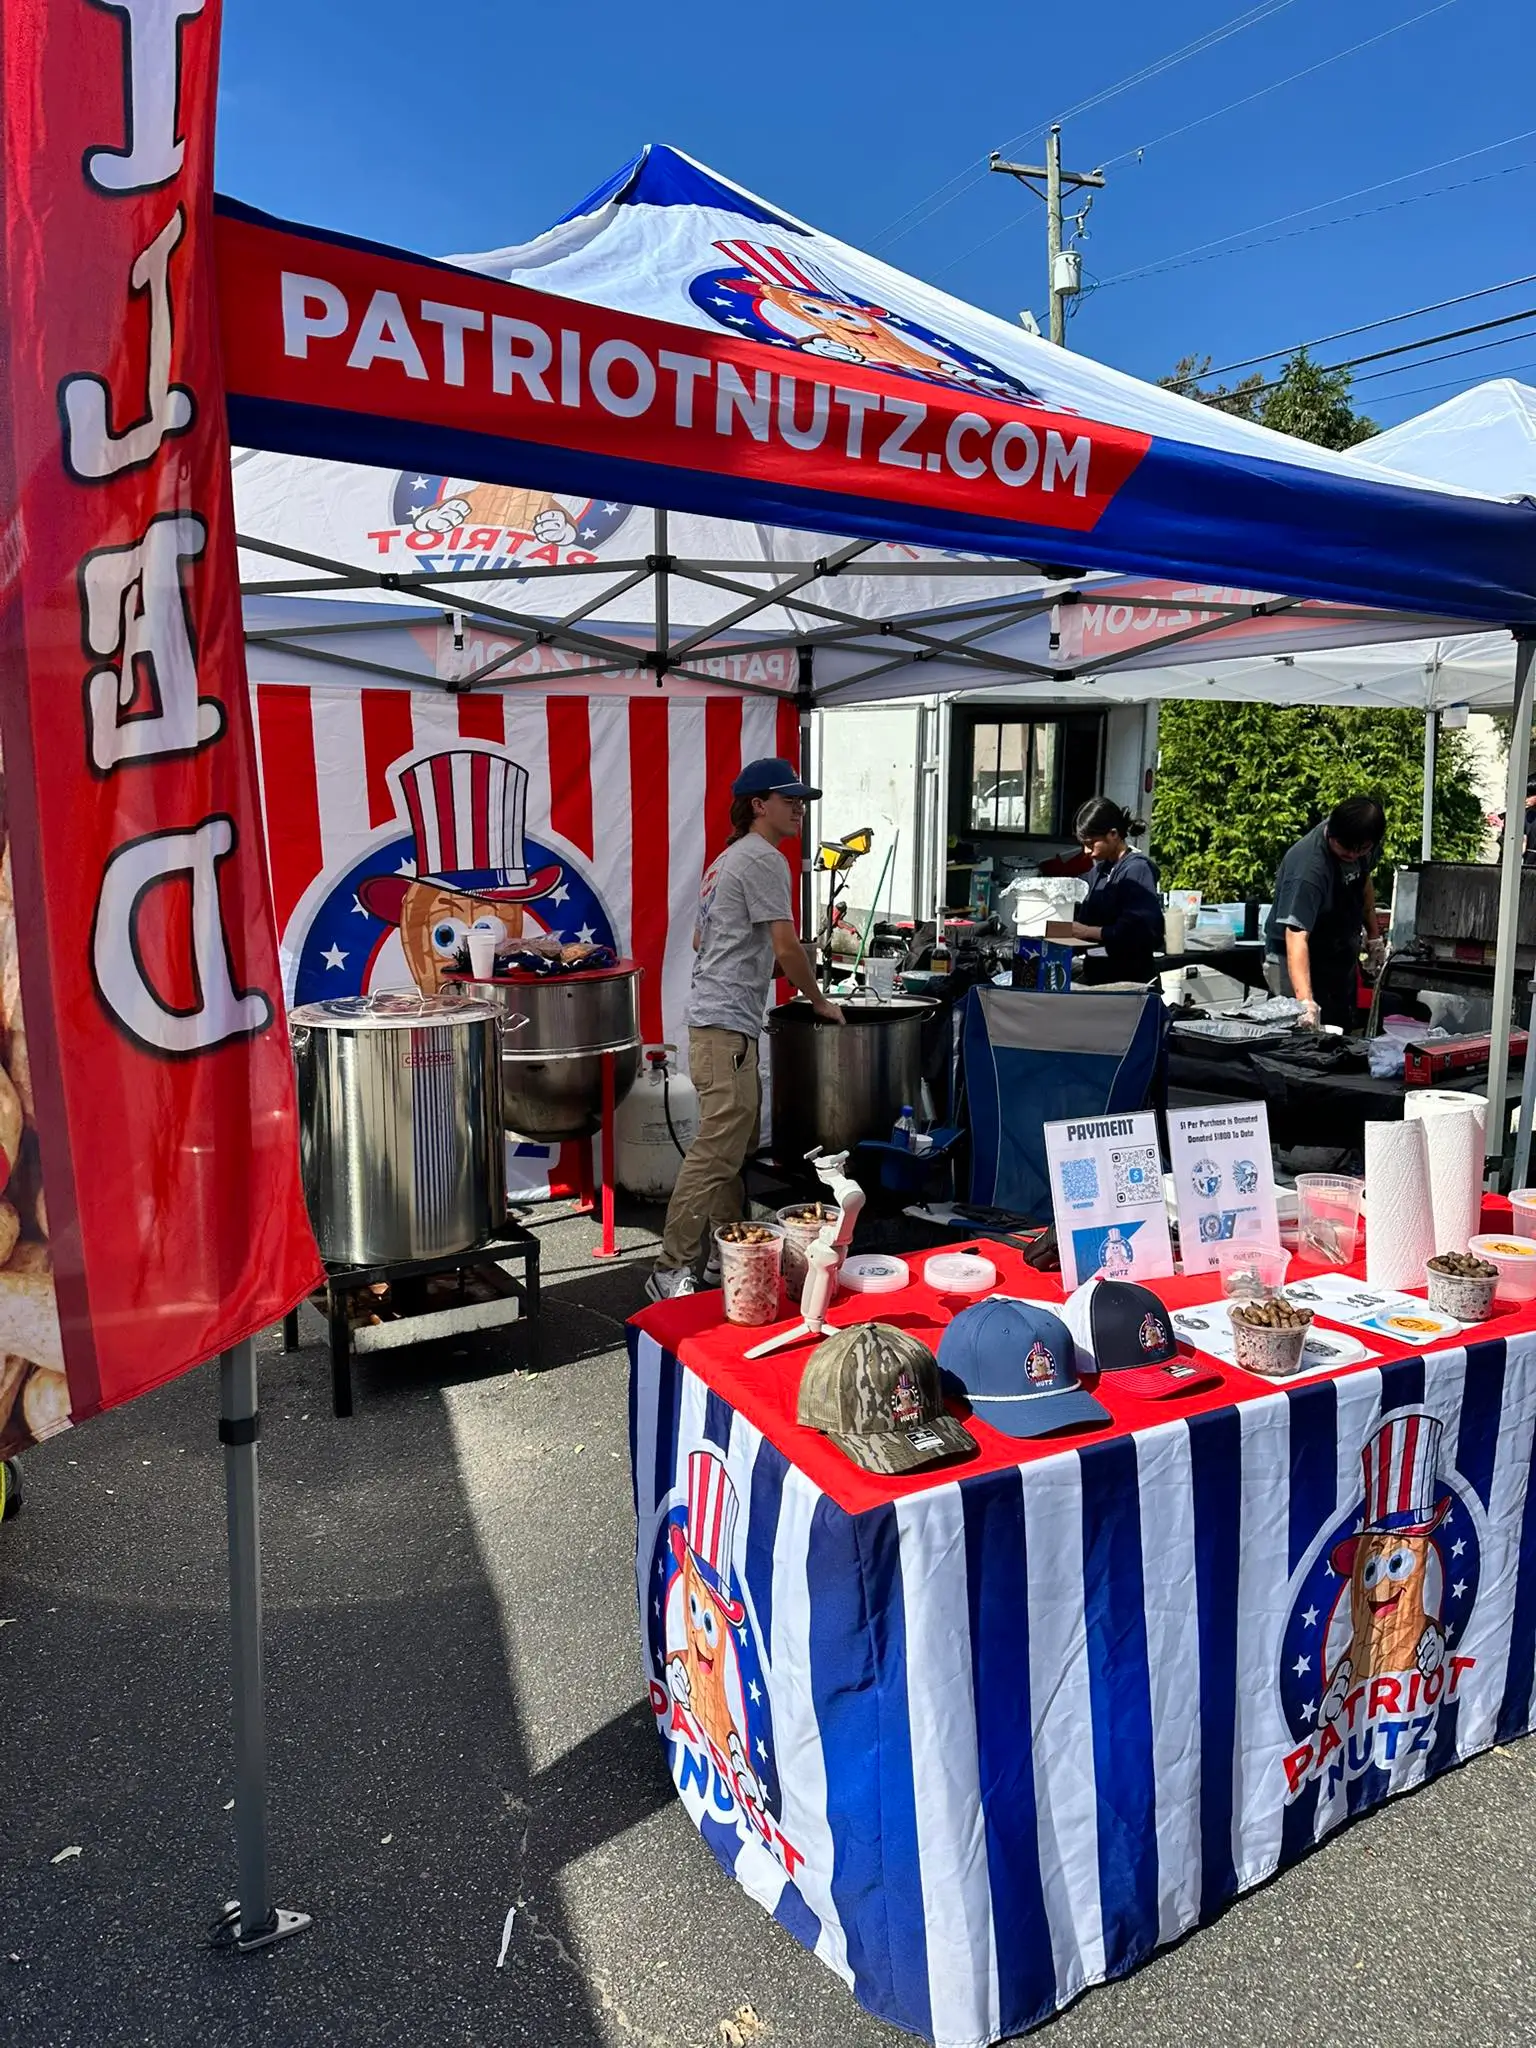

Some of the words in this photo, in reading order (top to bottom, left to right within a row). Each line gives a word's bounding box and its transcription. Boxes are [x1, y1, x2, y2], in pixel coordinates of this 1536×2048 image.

[280, 270, 1092, 498] PATRIOTNUTZ.COM
[1067, 1118, 1134, 1142] PAYMENT
[1187, 1133, 1213, 1143] Donated
[1234, 1114, 1258, 1125] Donated
[1282, 1656, 1476, 1793] PATRIOT
[1328, 1712, 1434, 1801] NUTZ
